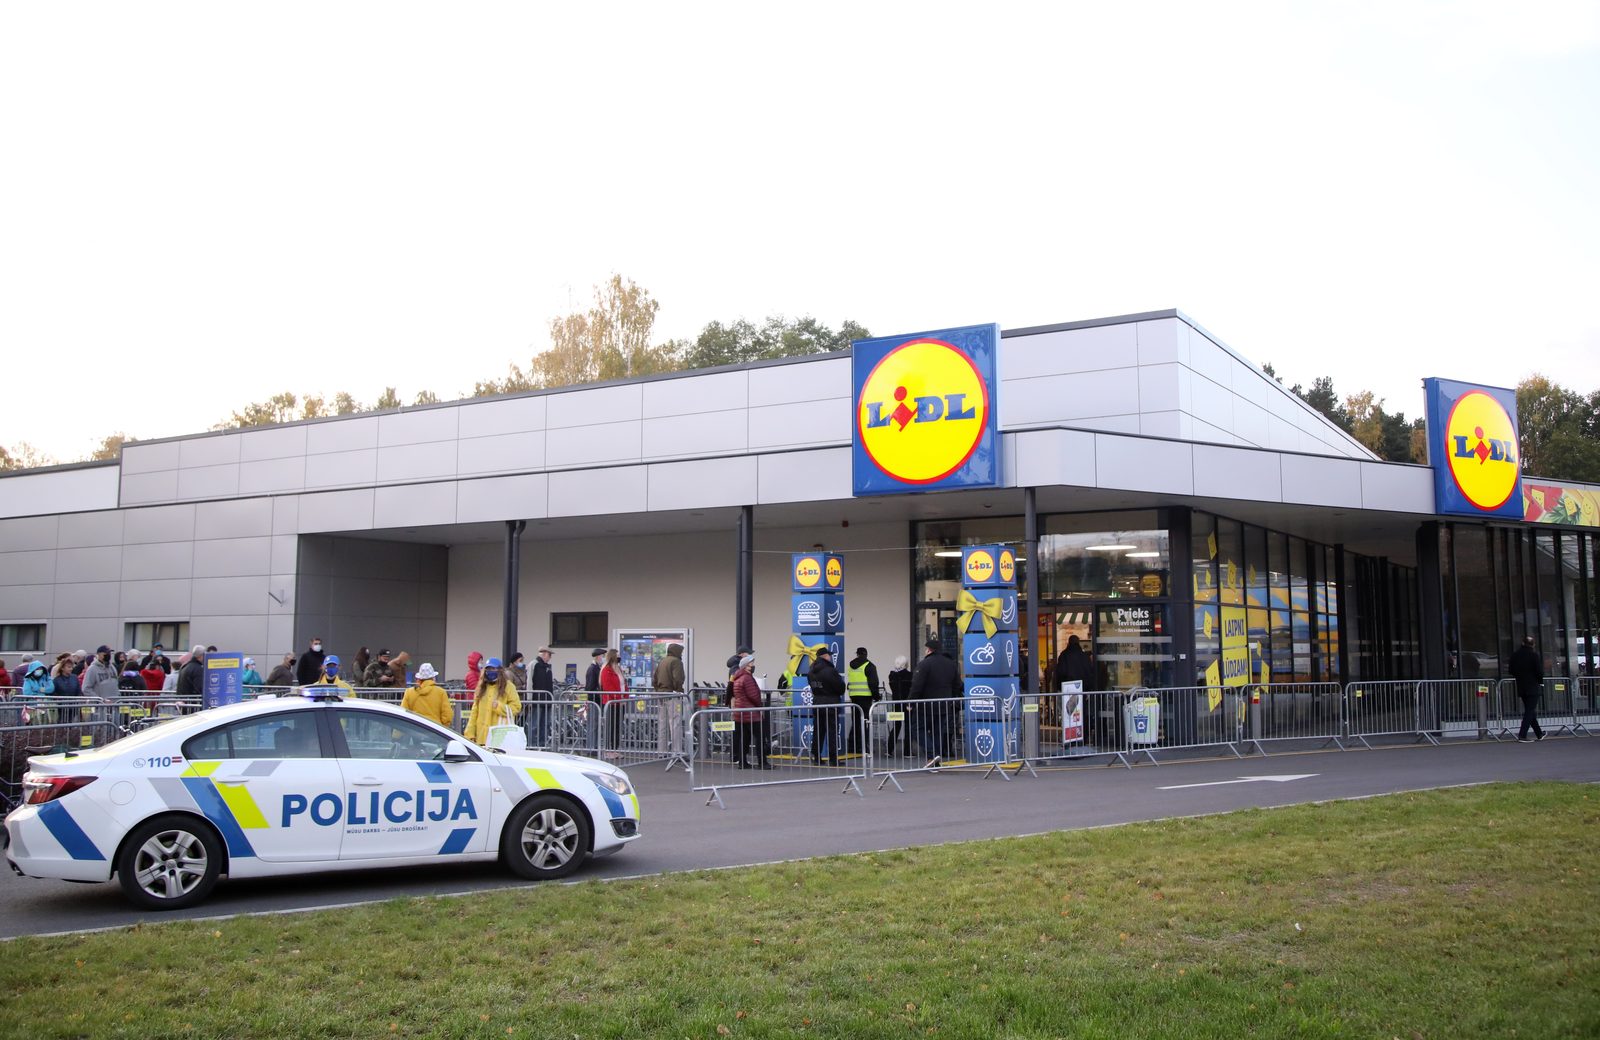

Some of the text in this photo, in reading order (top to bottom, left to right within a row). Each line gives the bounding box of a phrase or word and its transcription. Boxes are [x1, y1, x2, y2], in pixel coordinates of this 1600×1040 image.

[1117, 607, 1150, 620] Prieks
[147, 756, 171, 768] 110
[281, 788, 478, 828] POLICIJA
